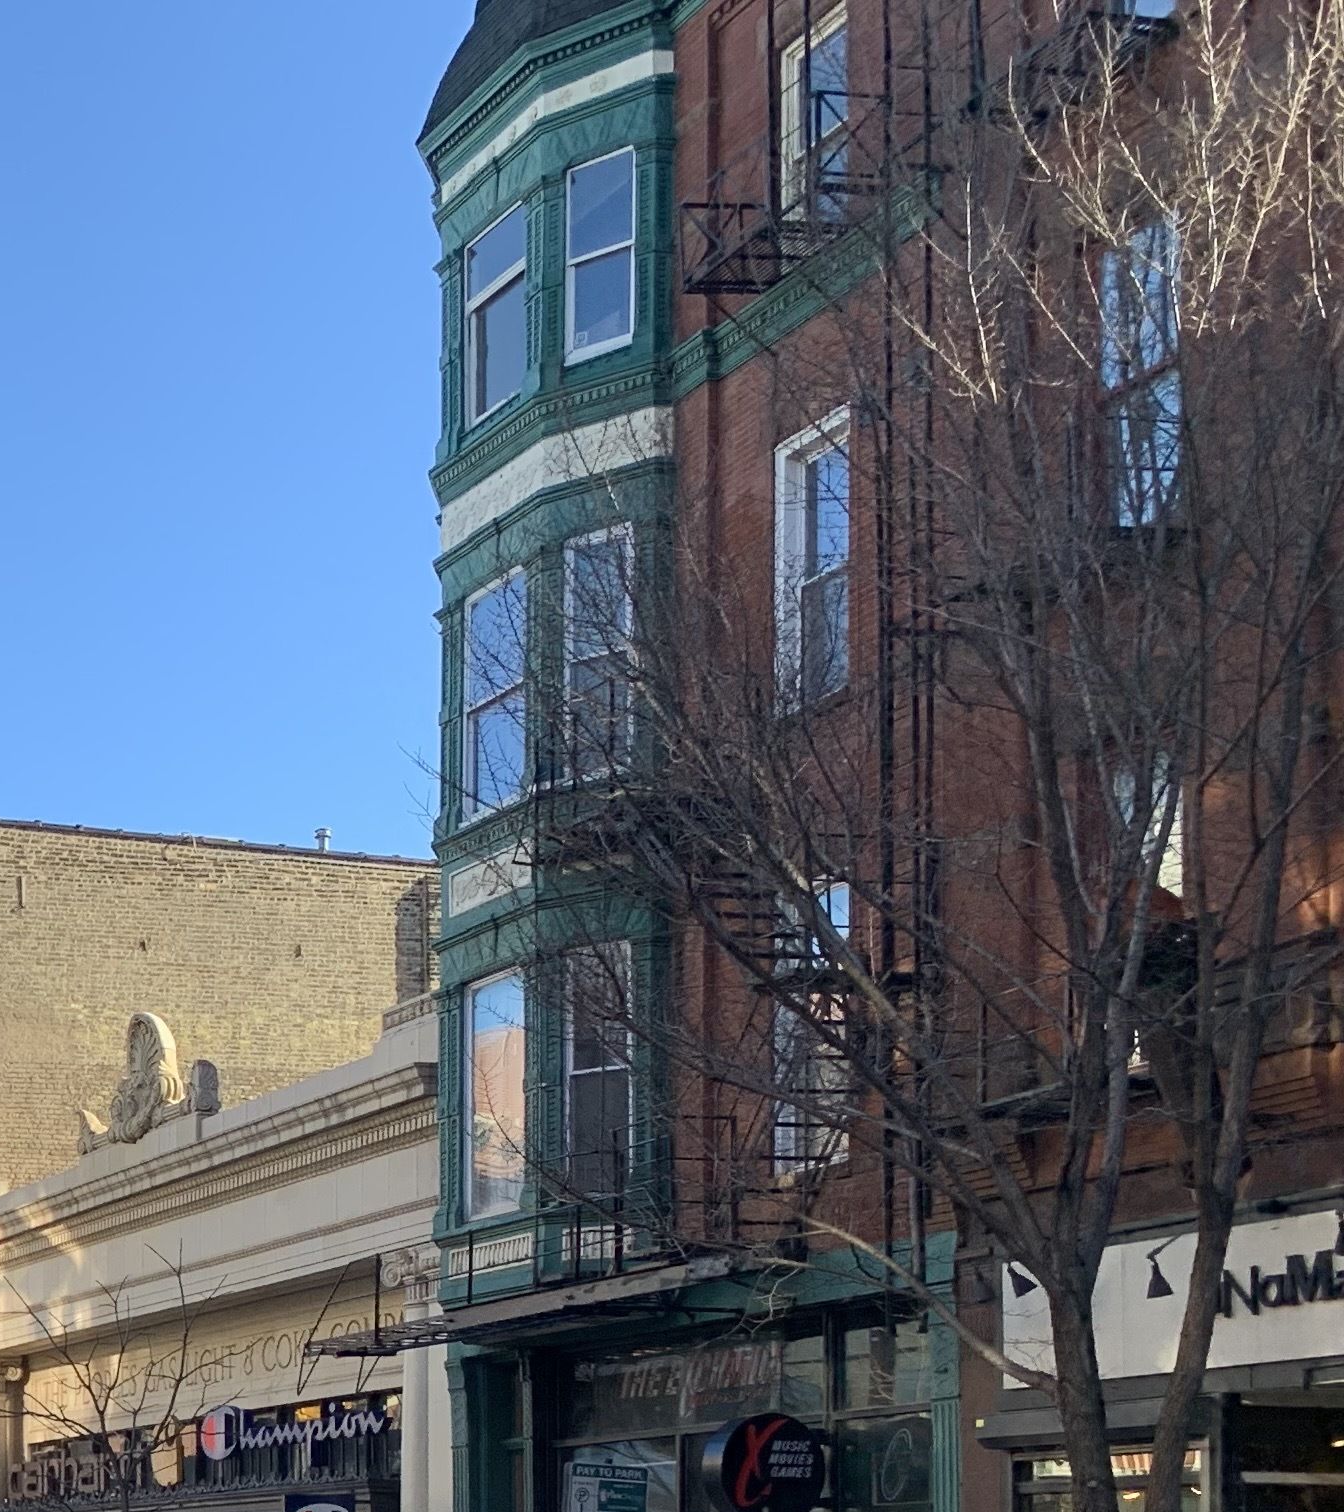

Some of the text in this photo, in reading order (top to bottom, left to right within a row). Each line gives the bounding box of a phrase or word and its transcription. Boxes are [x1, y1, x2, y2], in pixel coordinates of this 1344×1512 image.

[186, 1344, 237, 1387] LIGHT
[201, 1402, 384, 1461] Champion
[772, 1439, 812, 1451] MUSIC
[767, 1453, 813, 1465] MOVIES
[576, 1466, 643, 1480] PAY TO PARK
[770, 1466, 812, 1478] GAMES
